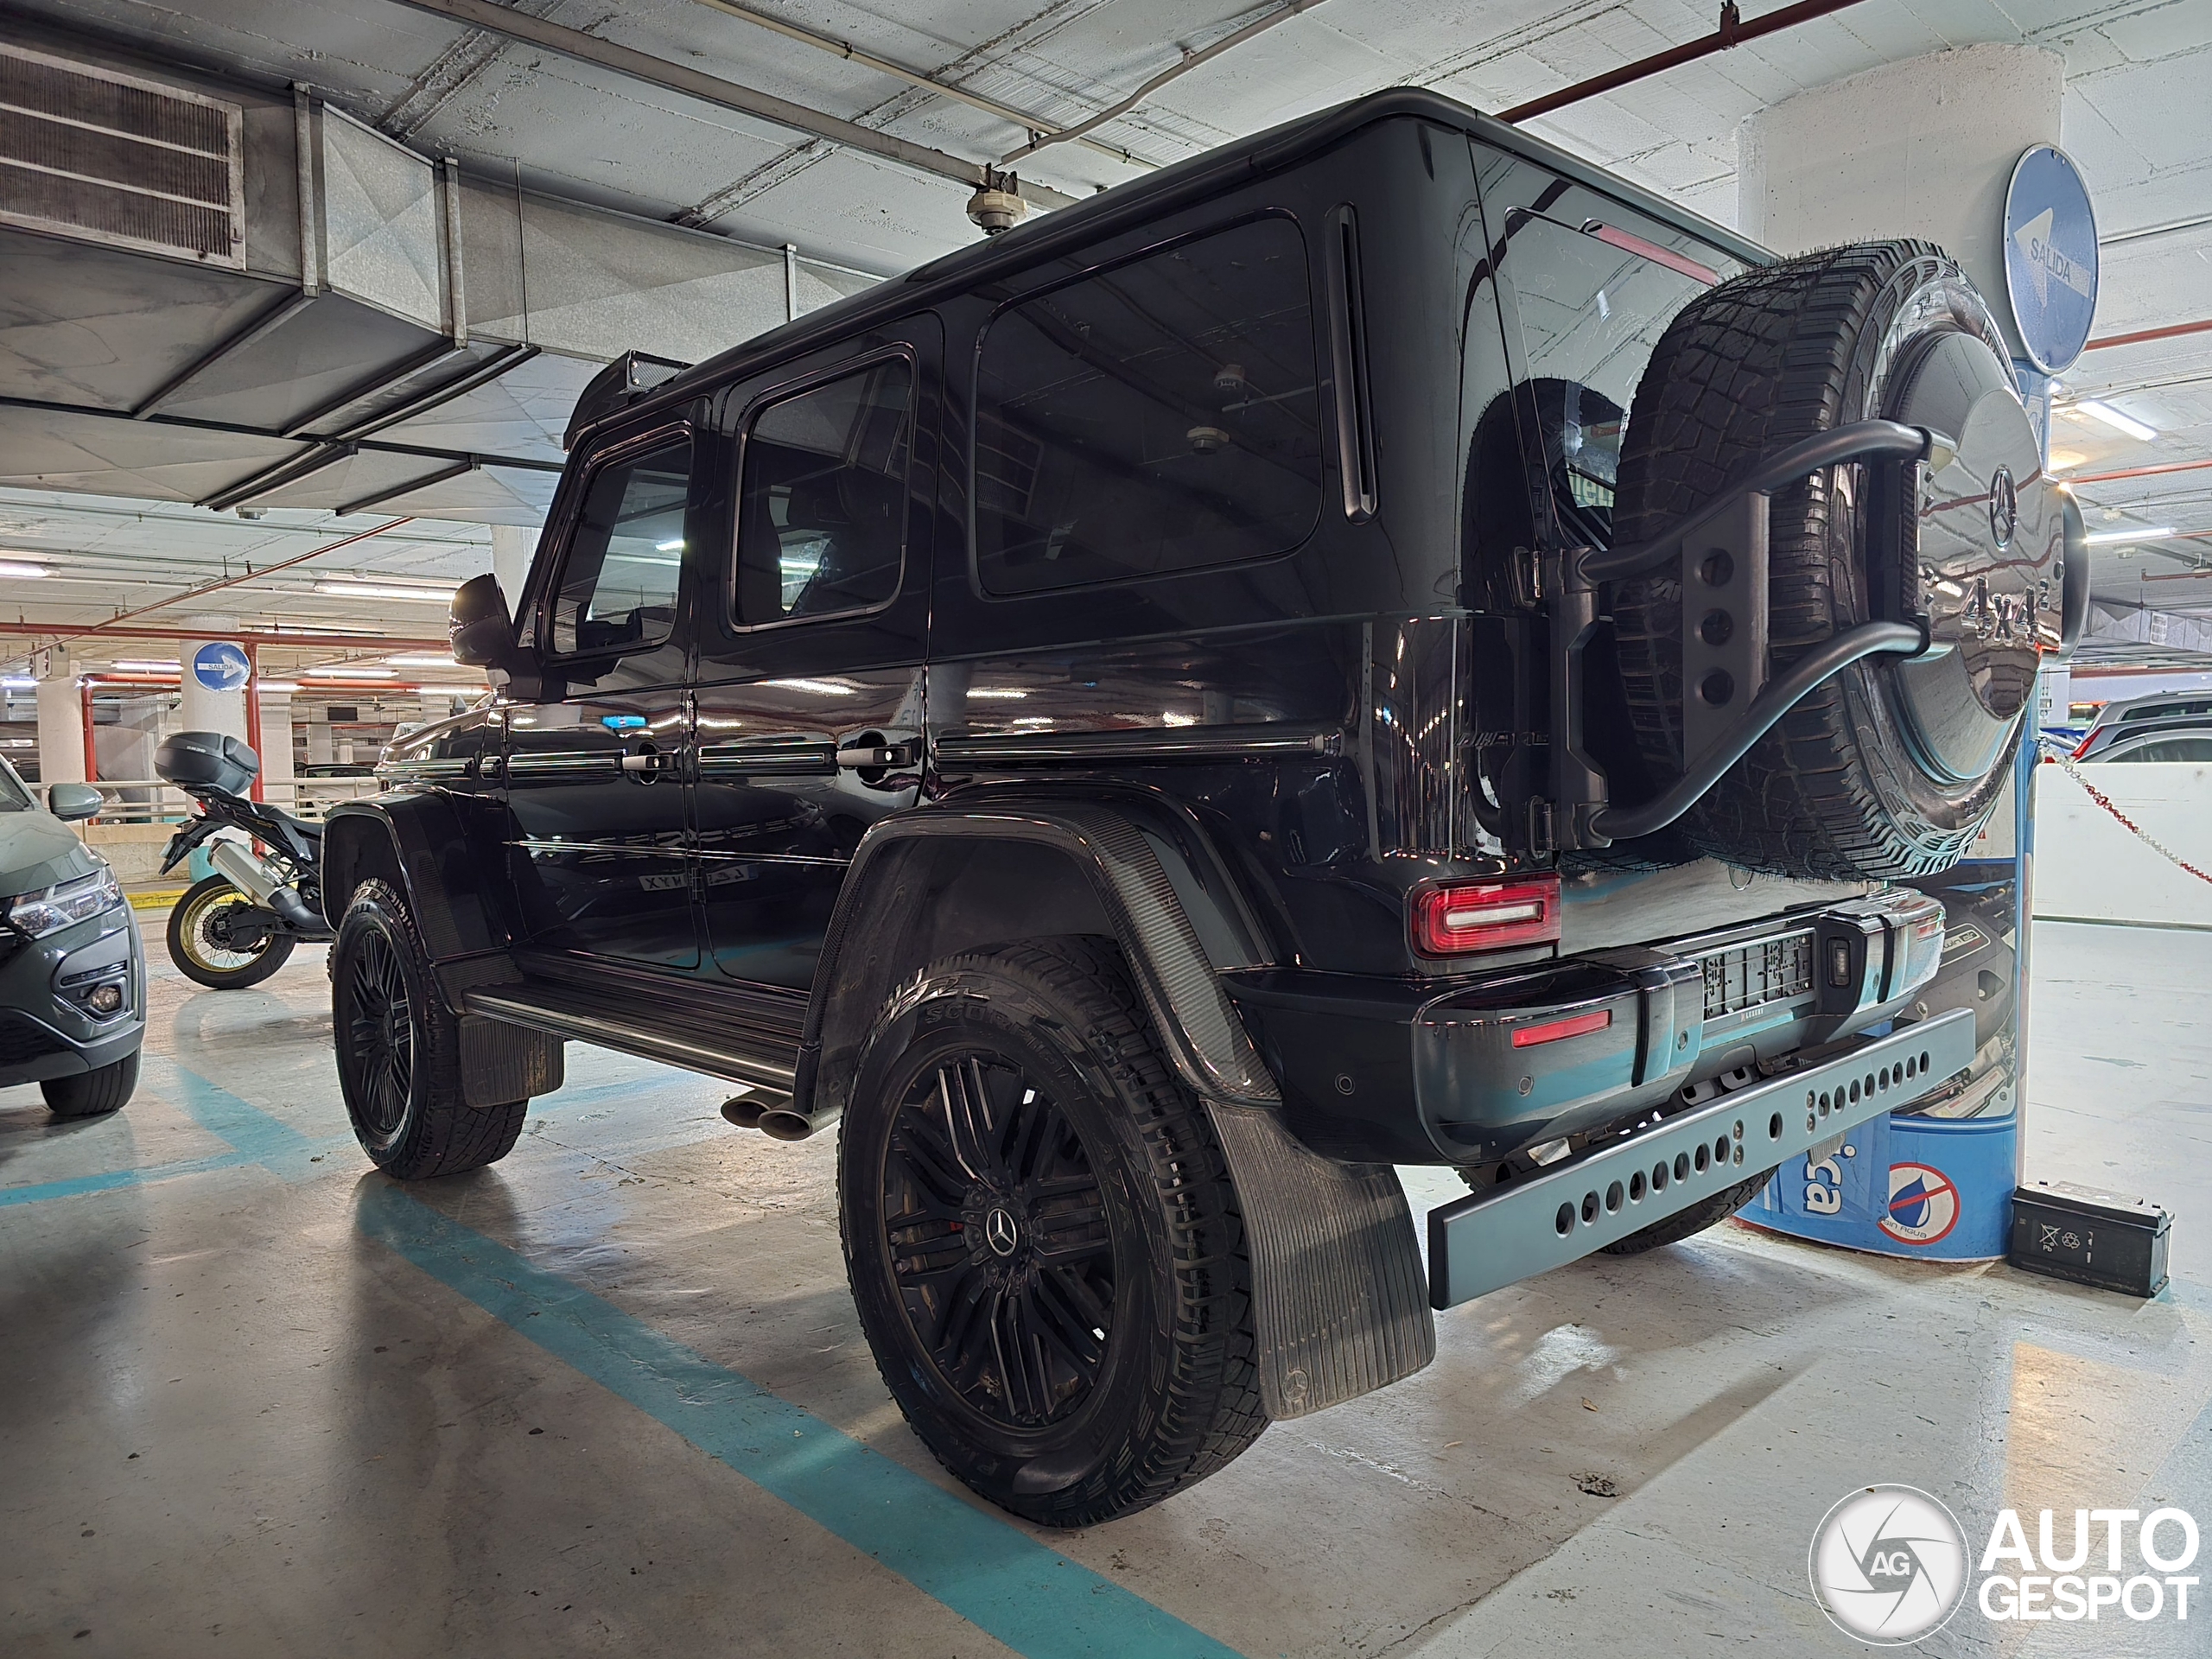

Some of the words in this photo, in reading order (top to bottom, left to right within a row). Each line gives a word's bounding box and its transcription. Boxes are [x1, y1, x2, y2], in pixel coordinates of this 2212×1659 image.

[2031, 237, 2070, 283] SALIDA
[1883, 1218, 1897, 1229] SIN
[1900, 1225, 1927, 1238] AGUA
